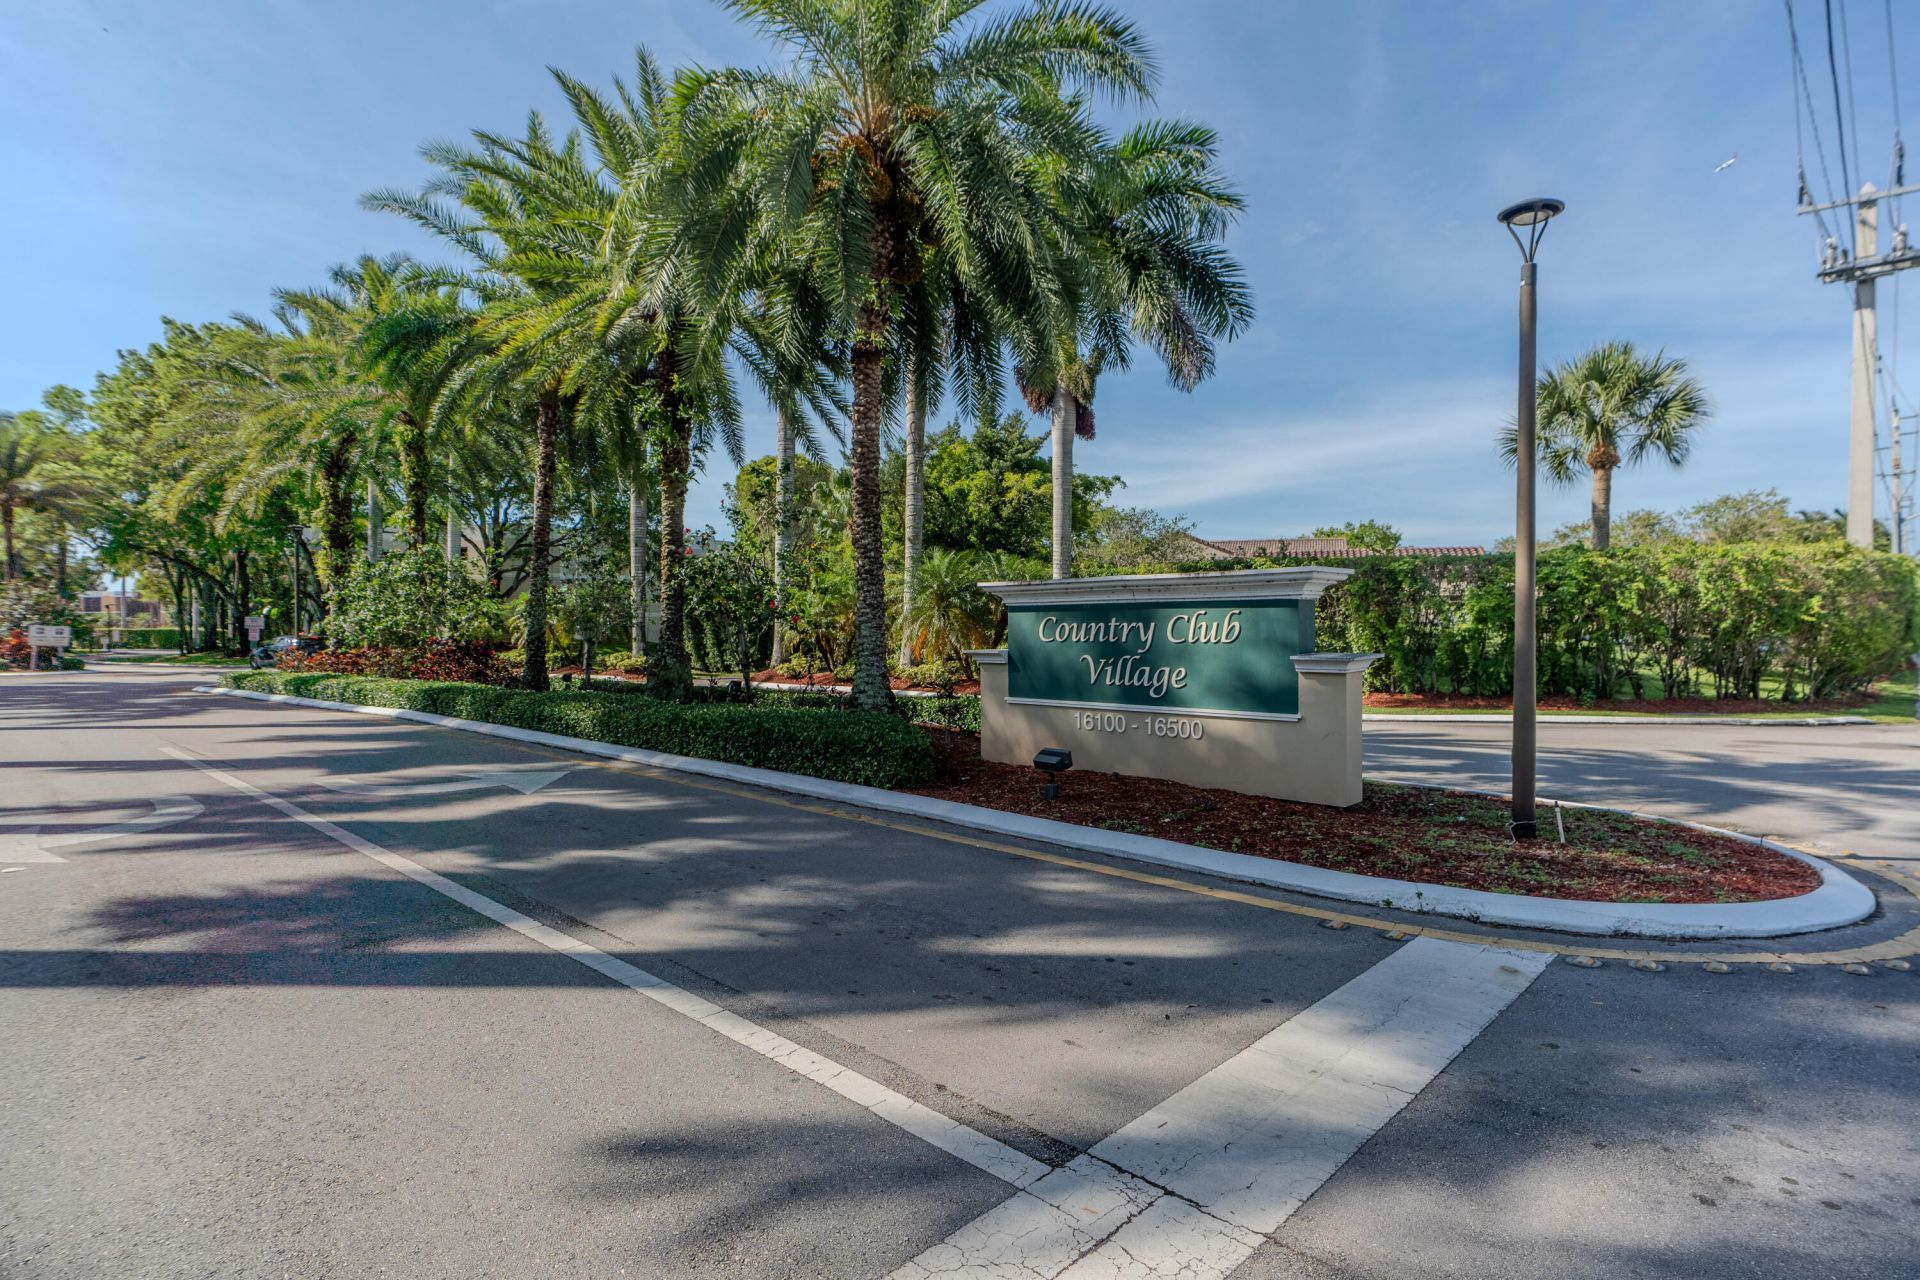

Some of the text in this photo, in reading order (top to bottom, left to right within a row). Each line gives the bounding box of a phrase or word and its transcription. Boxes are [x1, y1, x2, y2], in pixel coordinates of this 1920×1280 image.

[1038, 610, 1241, 653] Country Club
[1079, 654, 1187, 699] Village
[1073, 711, 1127, 733] 16100
[1145, 715, 1204, 740] 16500
